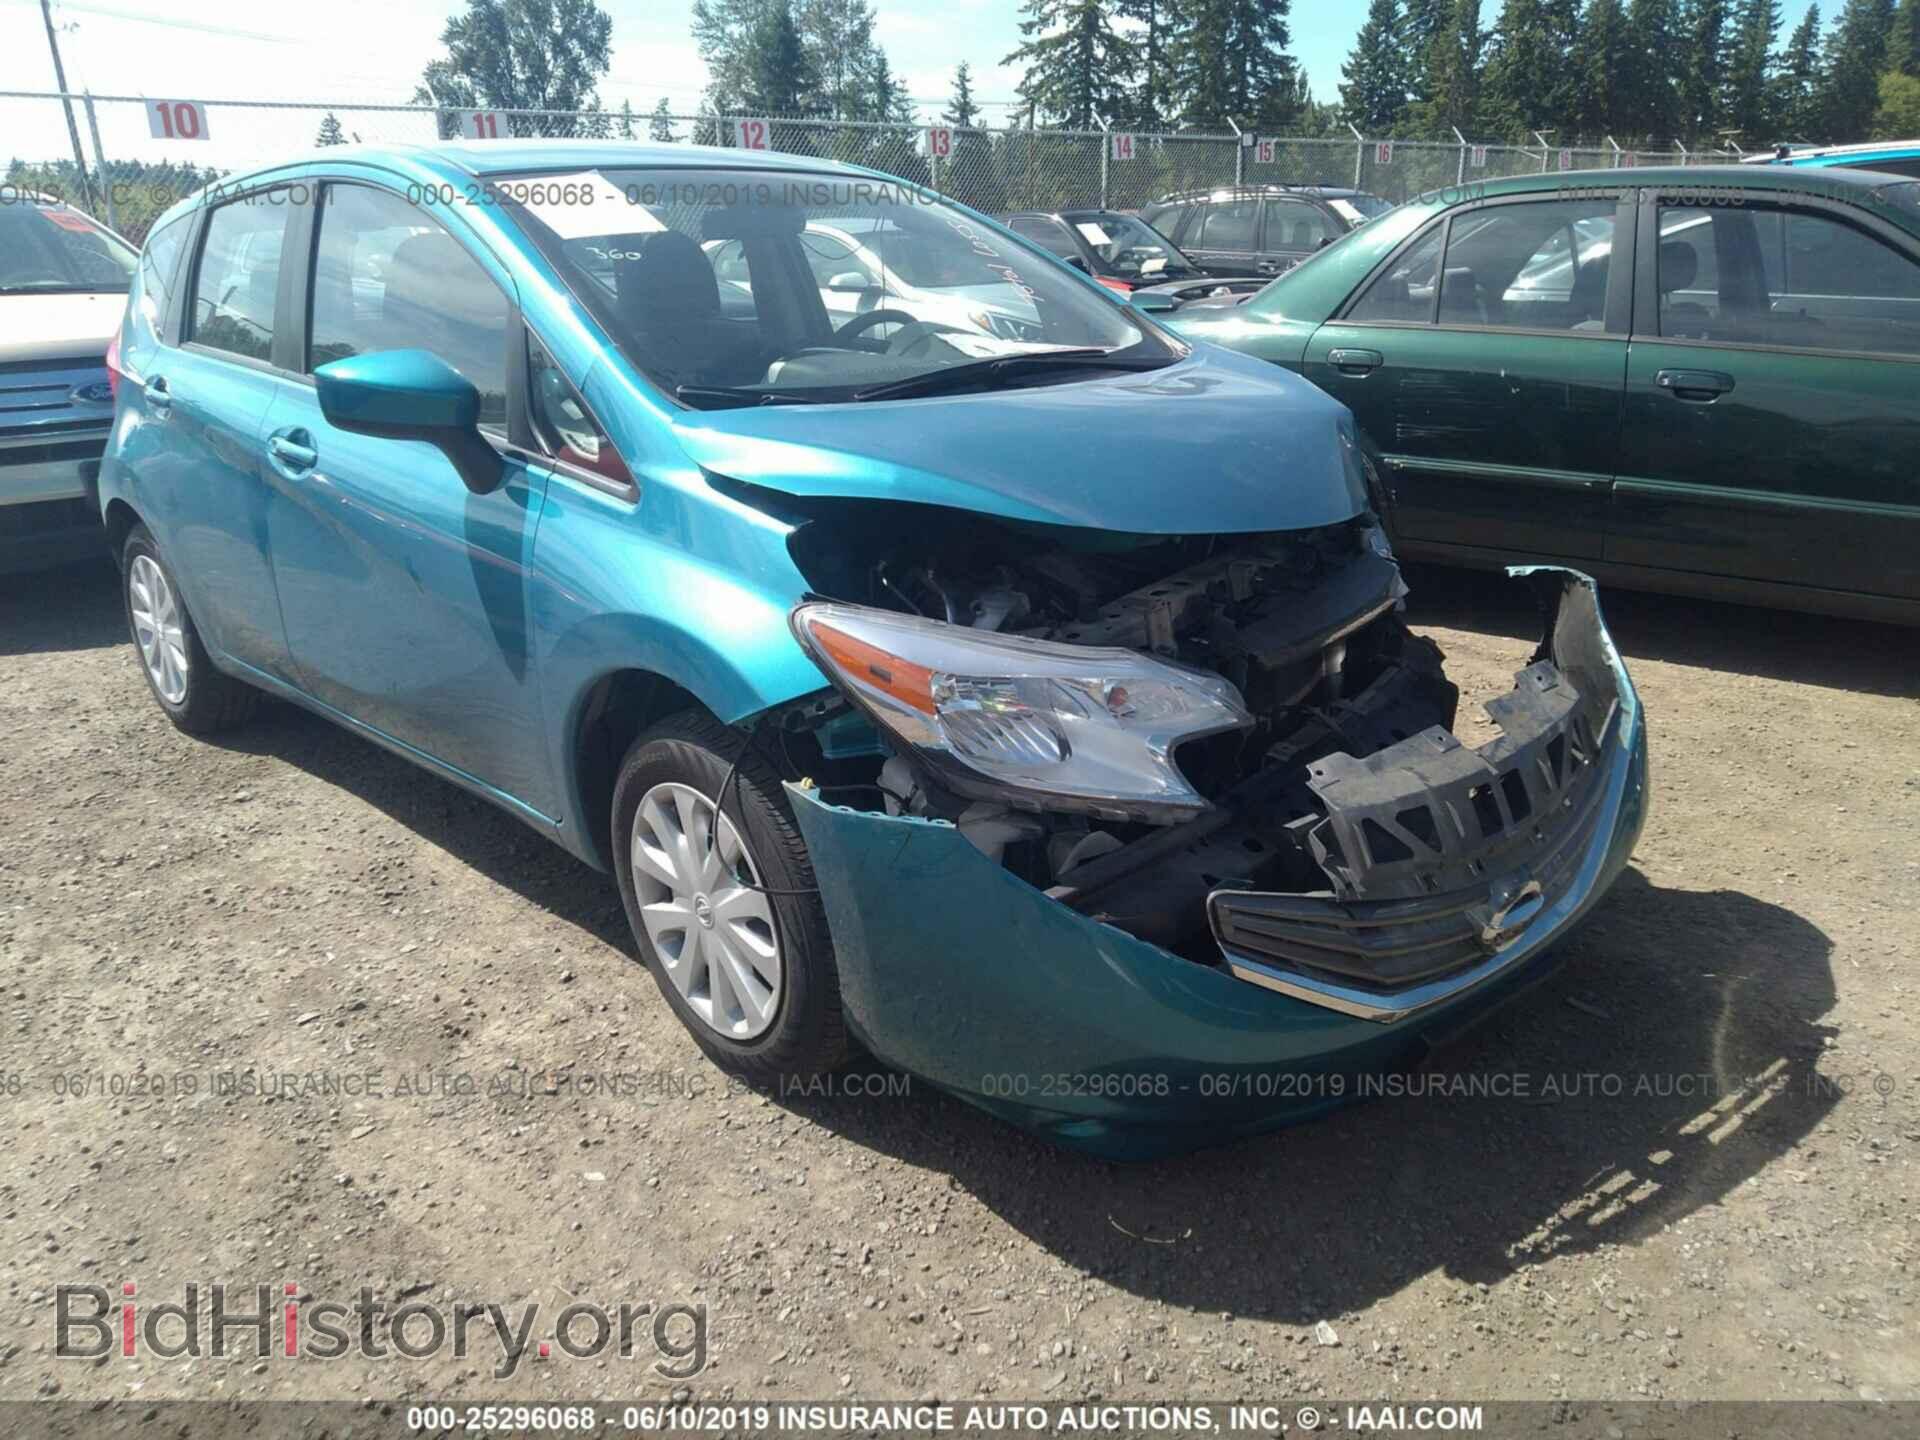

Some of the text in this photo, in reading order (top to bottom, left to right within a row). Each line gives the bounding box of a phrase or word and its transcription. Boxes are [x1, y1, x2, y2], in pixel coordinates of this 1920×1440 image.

[156, 102, 200, 139] 10
[472, 111, 497, 139] 11
[740, 121, 766, 150] 12
[930, 128, 950, 156] 13
[1115, 135, 1132, 158] 14
[1258, 142, 1272, 162] 15
[1378, 143, 1390, 163] 16
